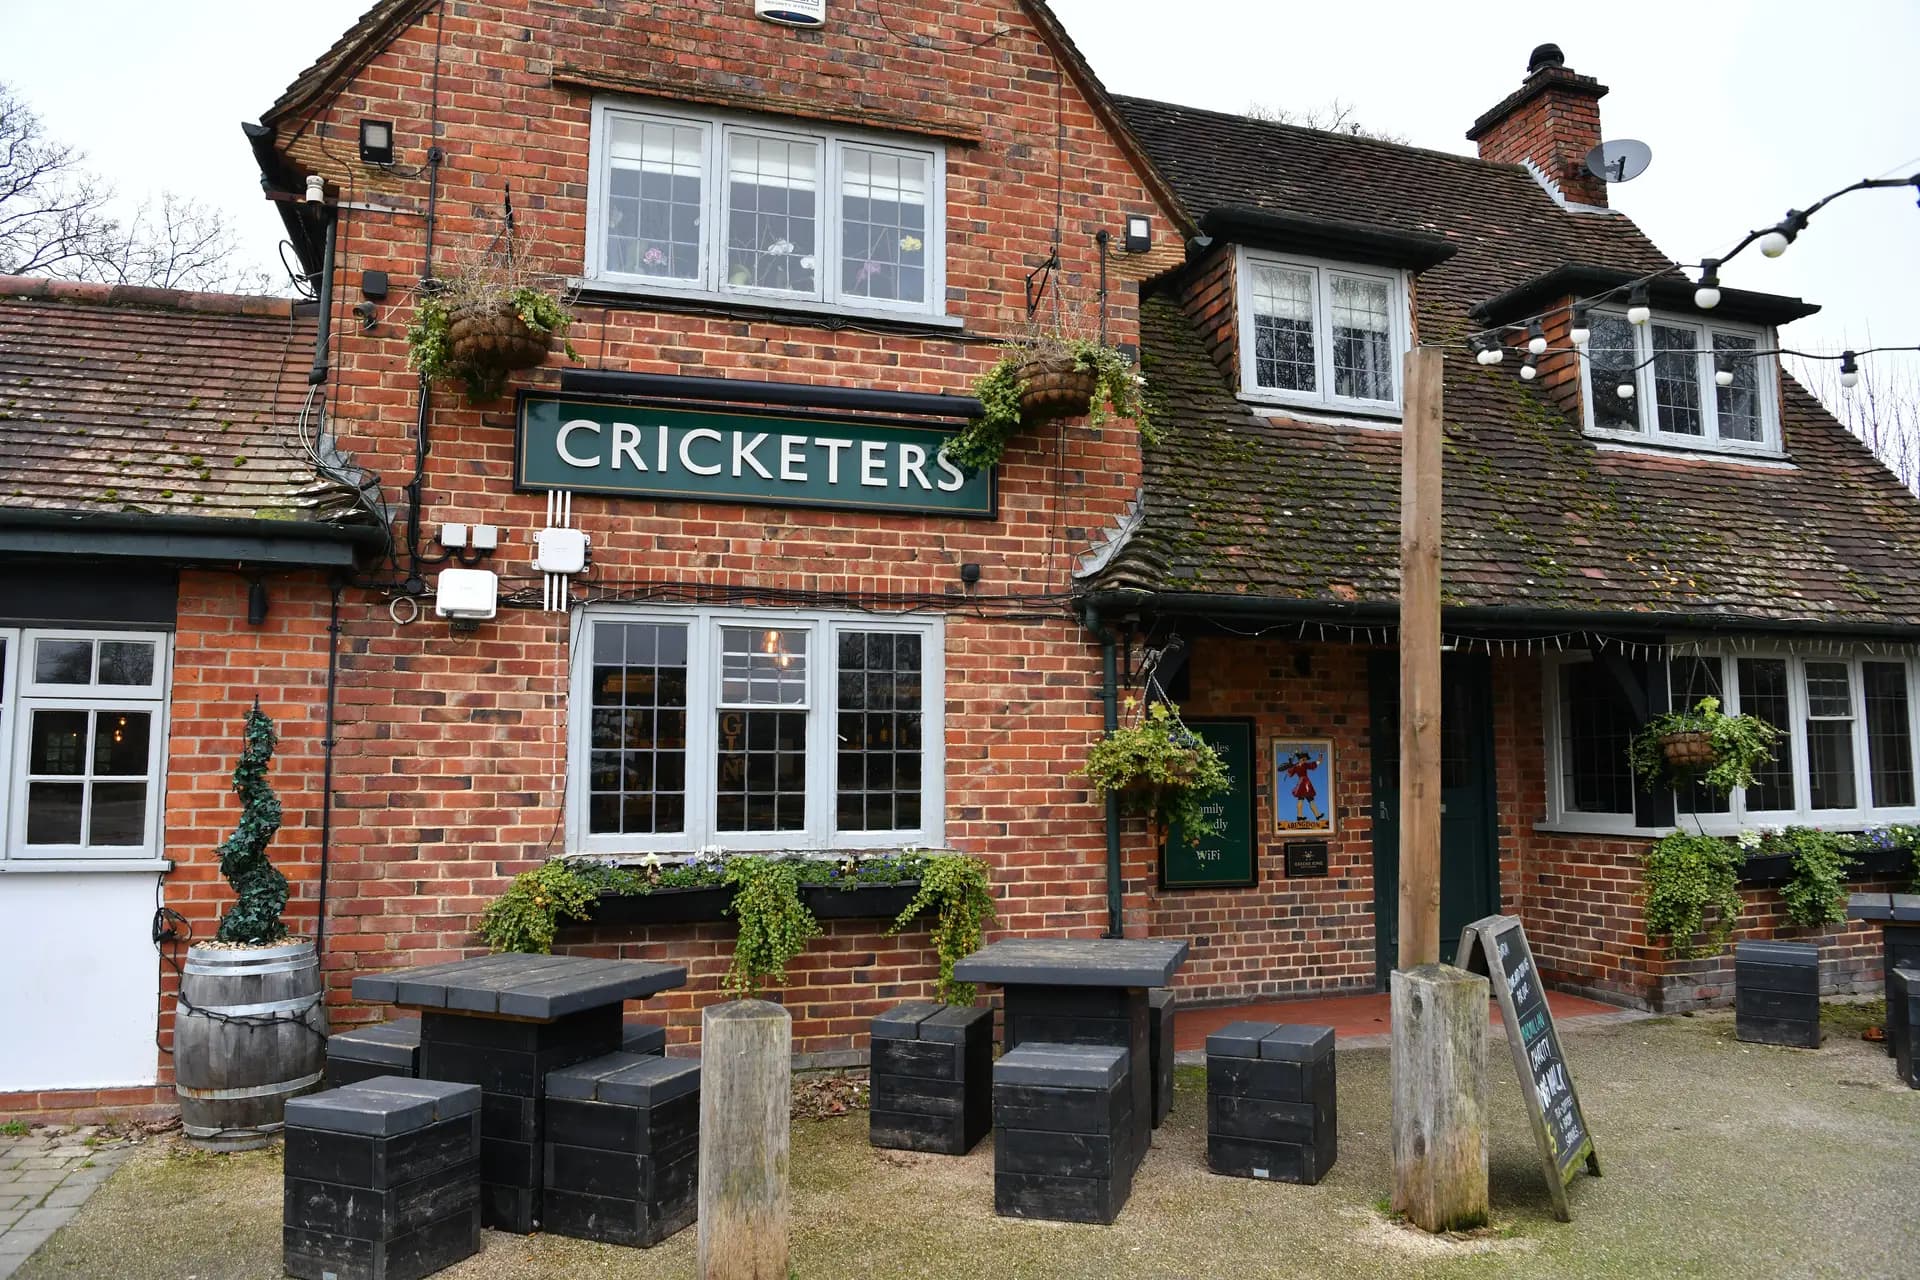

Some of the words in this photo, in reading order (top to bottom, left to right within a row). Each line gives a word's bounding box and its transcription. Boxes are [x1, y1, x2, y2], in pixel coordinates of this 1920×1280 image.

[556, 419, 964, 493] CRICKETERS
[1200, 804, 1224, 816] mily
[1196, 849, 1220, 861] WiFi
[1531, 1036, 1551, 1072] CHARITY
